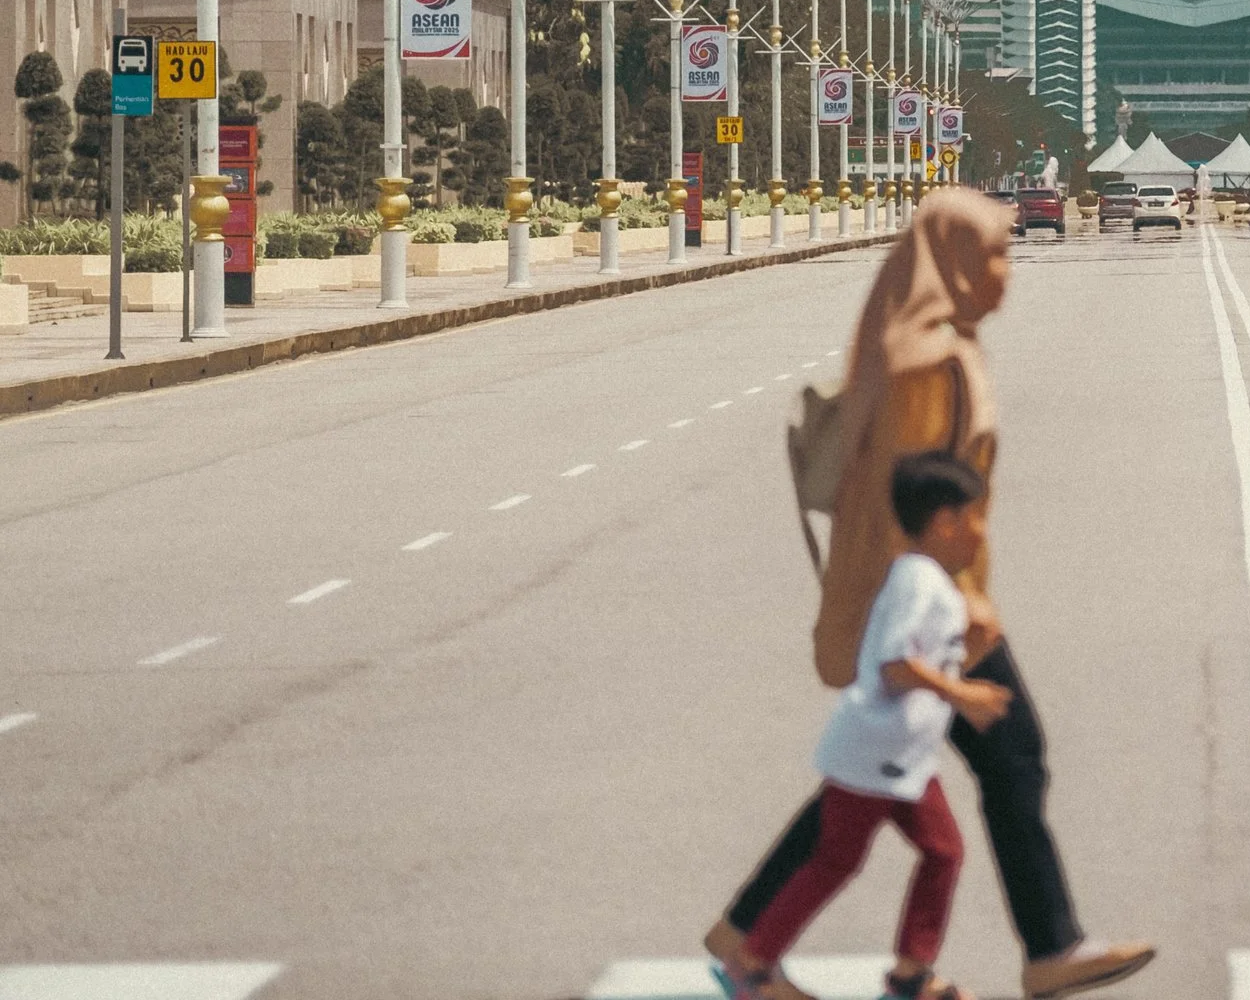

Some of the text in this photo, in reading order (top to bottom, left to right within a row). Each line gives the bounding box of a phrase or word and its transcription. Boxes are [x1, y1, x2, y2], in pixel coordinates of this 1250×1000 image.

[411, 13, 460, 27] ASEAN
[165, 45, 208, 56] HAD LAJU
[169, 57, 205, 83] 30
[688, 71, 720, 80] ASEAN
[721, 124, 738, 136] 30
